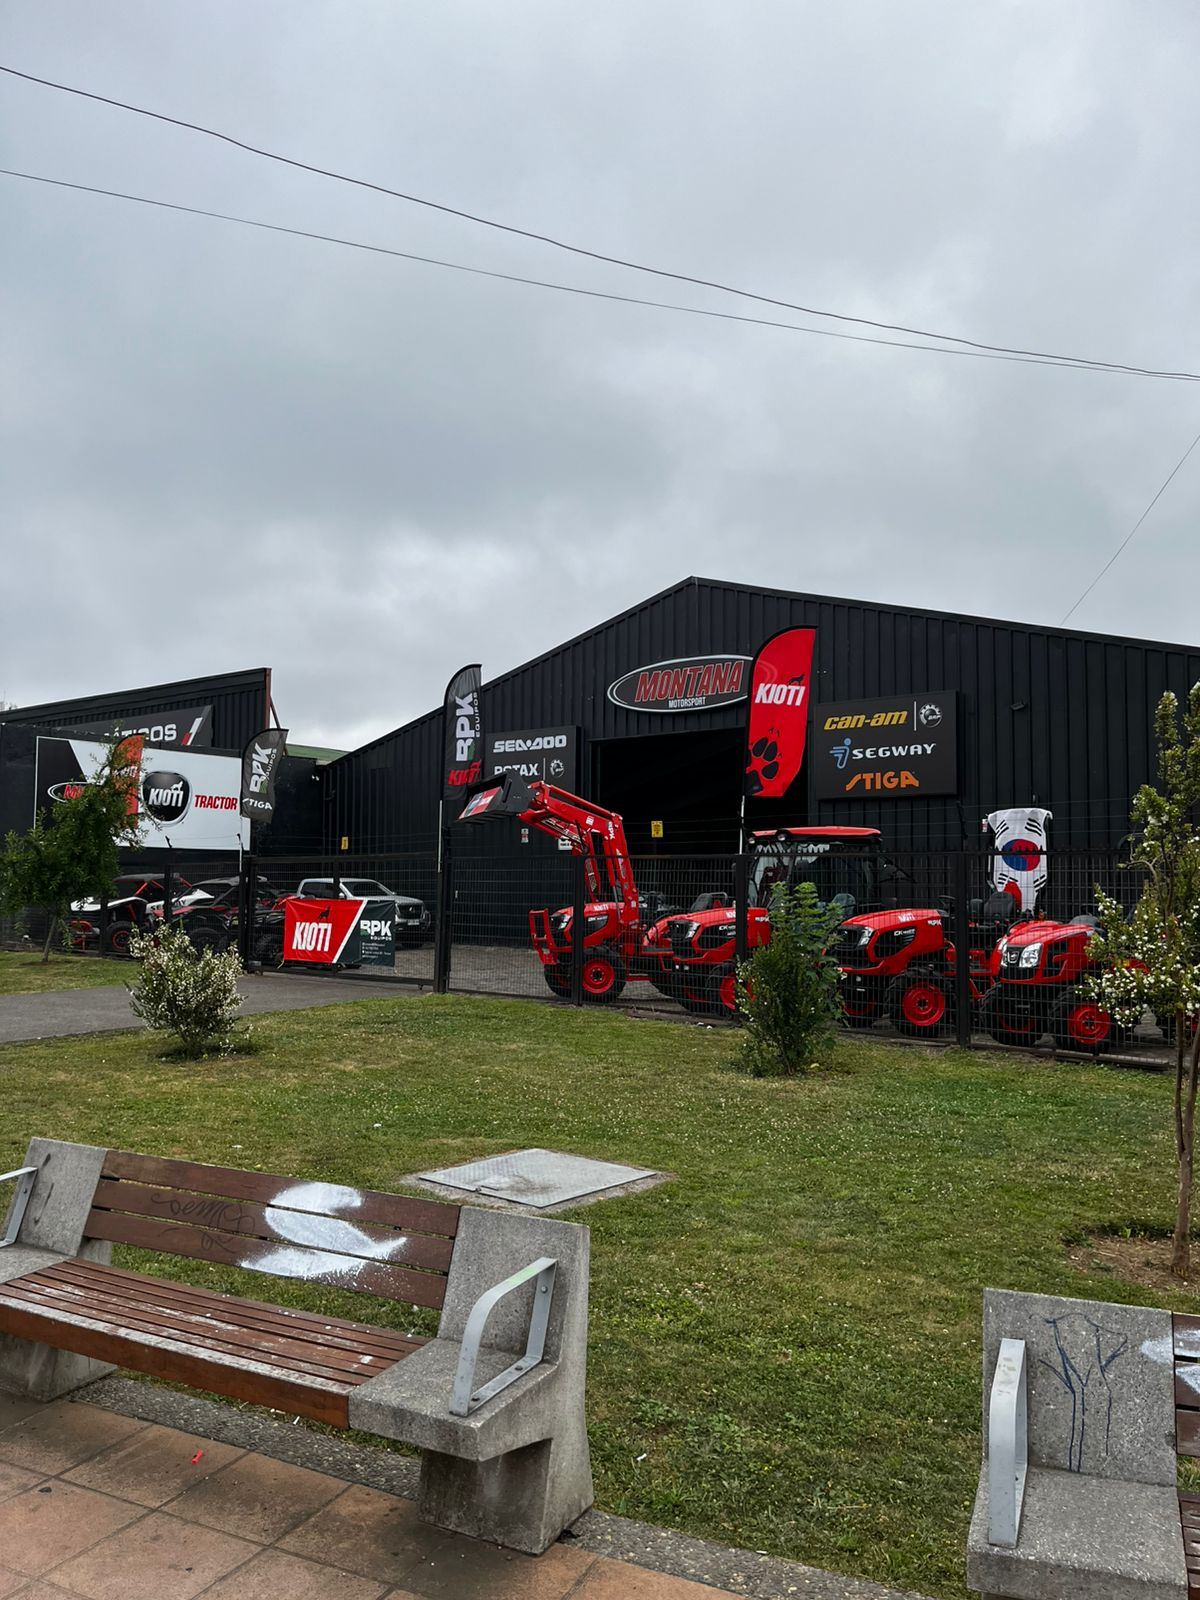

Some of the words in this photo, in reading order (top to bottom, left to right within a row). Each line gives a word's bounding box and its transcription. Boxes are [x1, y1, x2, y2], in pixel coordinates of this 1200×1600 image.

[635, 660, 744, 703] MONTANA
[668, 697, 707, 709] MOTORSPORT
[755, 683, 806, 707] KIOTI
[473, 692, 481, 738] EQUIPOS
[823, 710, 908, 731] can-am
[455, 692, 475, 762] RPK
[851, 742, 937, 760] SEGWAY
[844, 770, 920, 791] STIGA
[149, 788, 184, 807] KIOTI
[194, 794, 238, 810] TRACTOR
[292, 921, 332, 952] KIOTI
[360, 920, 392, 936] RPK
